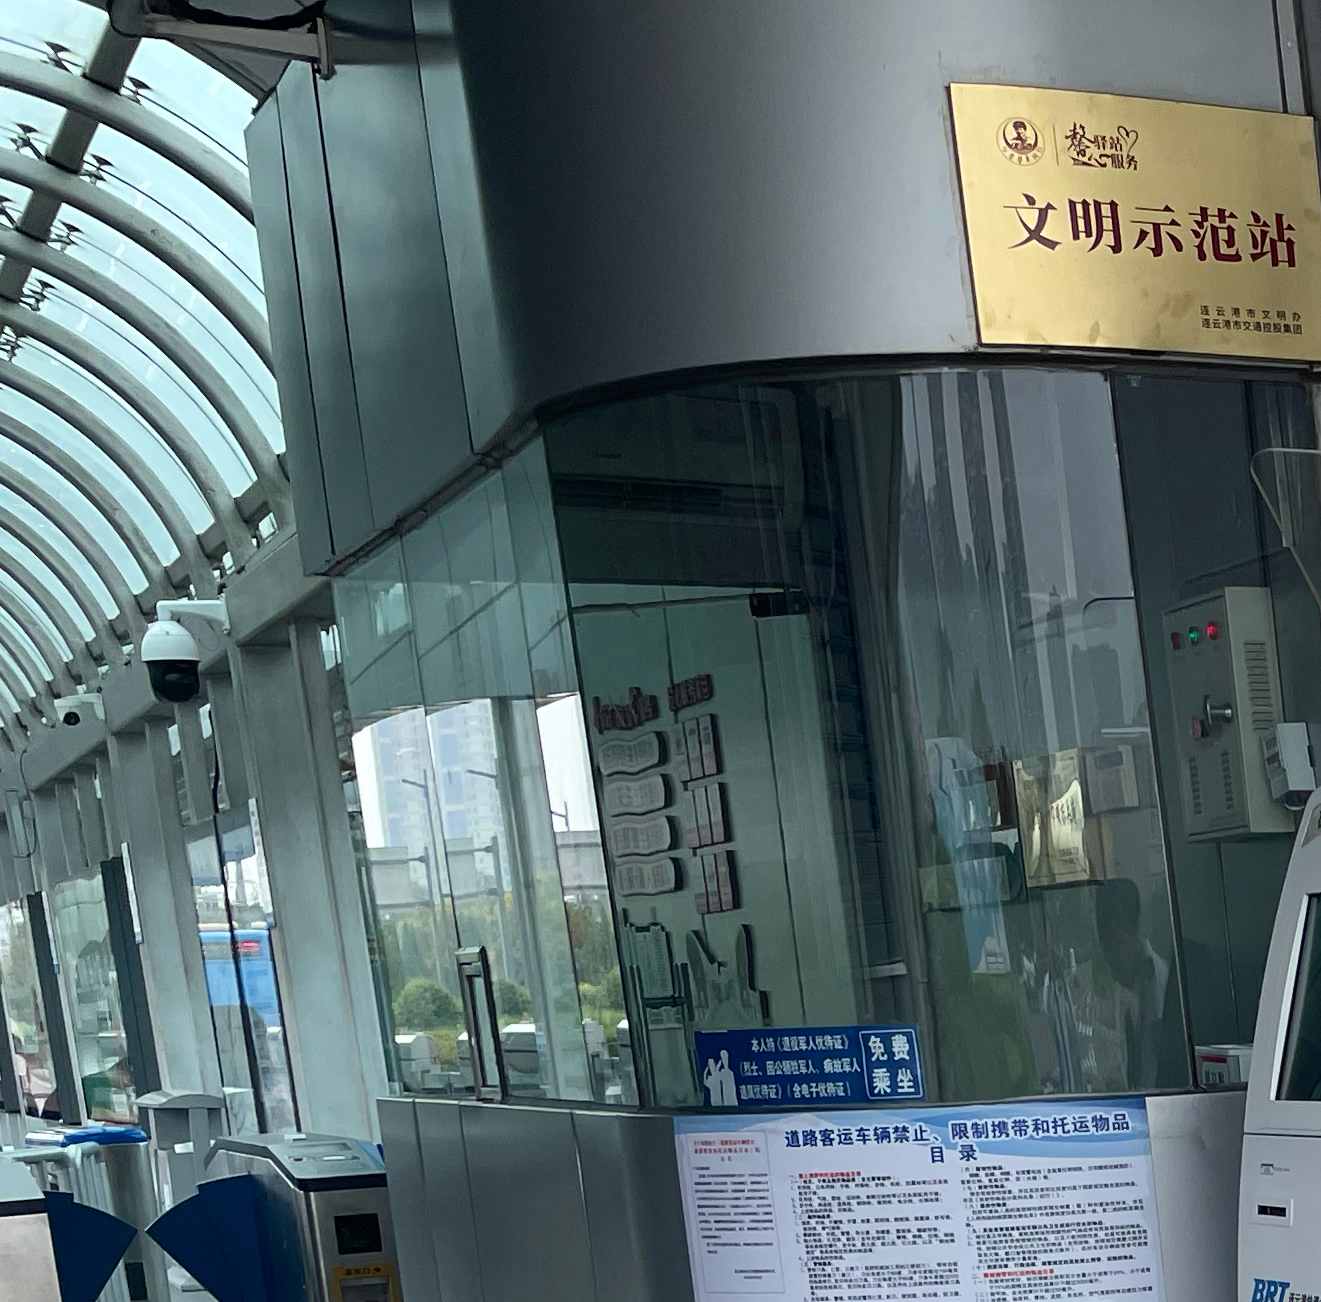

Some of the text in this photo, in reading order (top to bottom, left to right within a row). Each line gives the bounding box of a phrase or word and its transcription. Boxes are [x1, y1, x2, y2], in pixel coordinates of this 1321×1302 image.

[1002, 192, 1297, 268] 文明示范站
[1200, 304, 1302, 322] 连云港市文明办
[1201, 318, 1303, 335] 连云港市交通控股集团
[868, 1034, 910, 1062] 免费
[872, 1068, 916, 1095] 乘坐
[784, 1113, 1131, 1149] 道路客运车辆禁止、限制携带和托运物品
[929, 1145, 978, 1164] 目录
